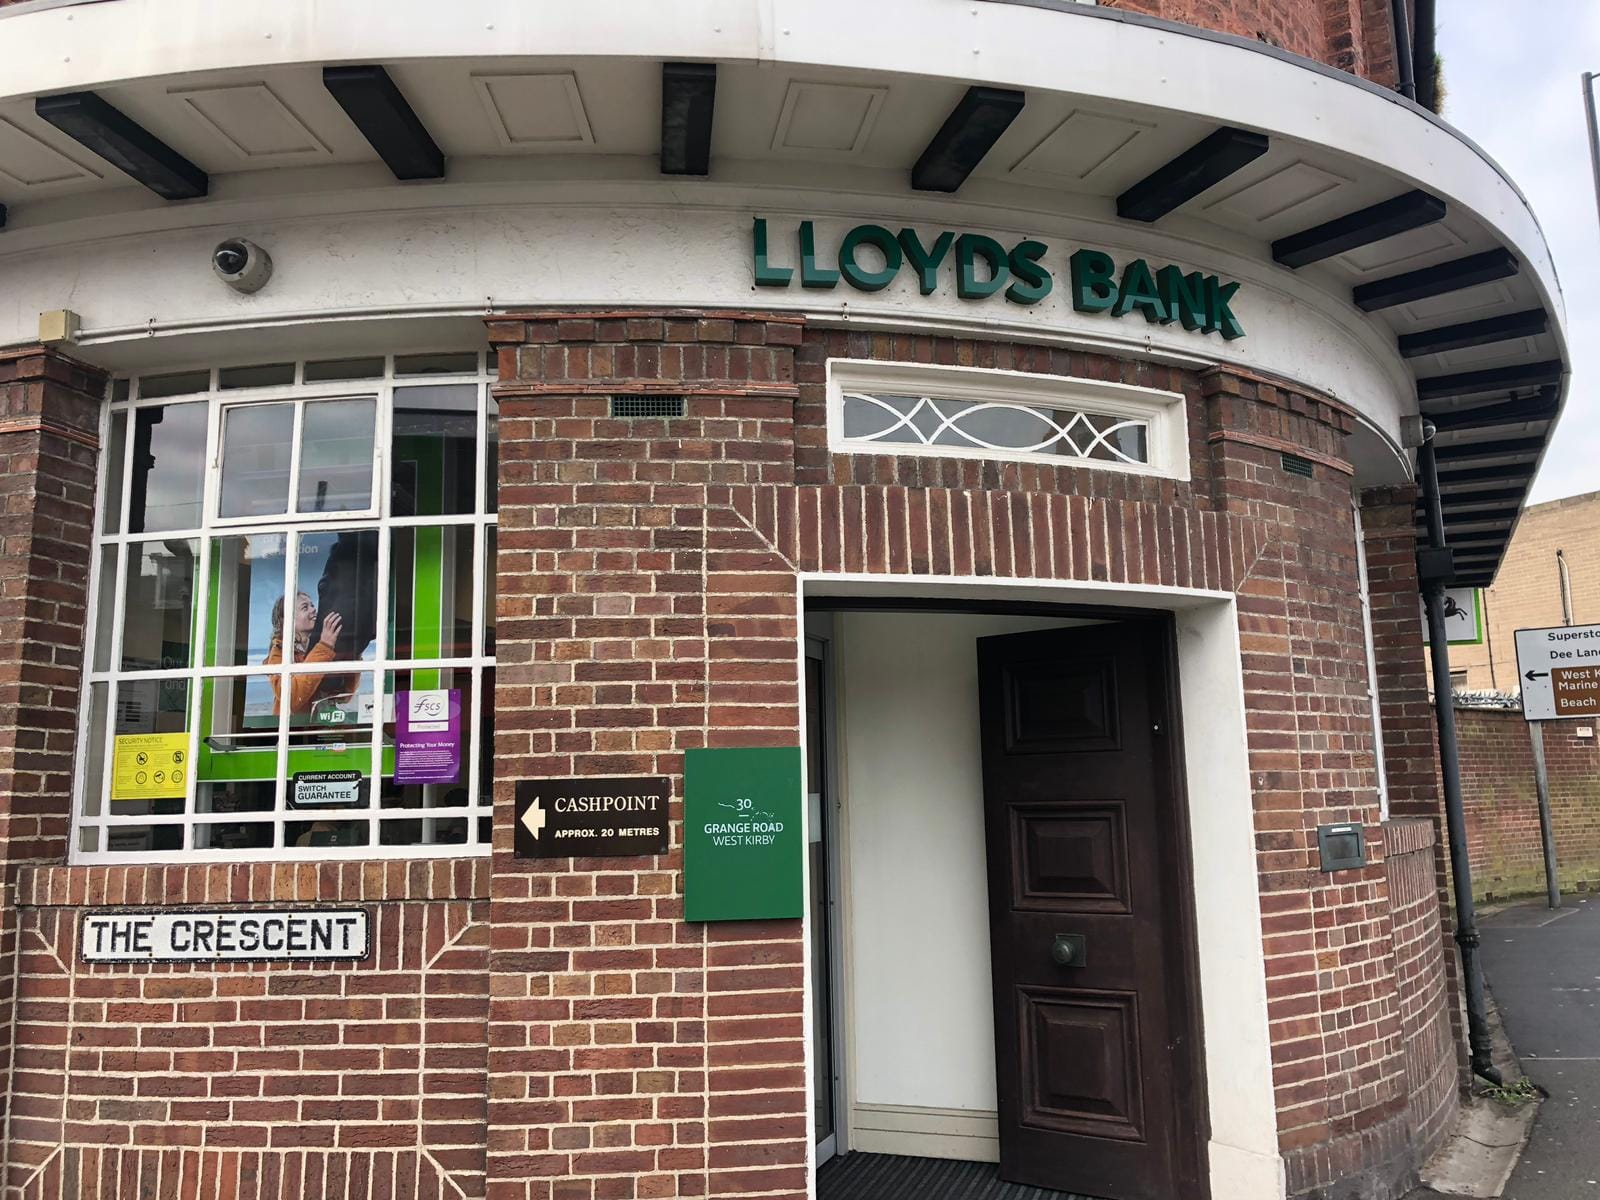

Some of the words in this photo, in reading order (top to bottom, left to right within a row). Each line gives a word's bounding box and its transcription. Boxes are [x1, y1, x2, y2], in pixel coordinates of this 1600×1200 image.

[753, 218, 1054, 304] LLOYDS
[1069, 248, 1246, 341] BANK
[1550, 649, 1572, 659] Dee
[1561, 669, 1590, 679] West
[1558, 680, 1598, 691] Marine
[1560, 697, 1596, 707] Beach
[297, 791, 352, 800] GUARANTEE
[555, 796, 659, 812] CASHPOINT
[736, 798, 751, 811] 30
[555, 829, 598, 838] APPROX.
[601, 828, 614, 837] 20
[618, 827, 659, 837] METRES
[704, 822, 750, 833] GRANGE
[752, 822, 783, 832] ROAD
[713, 835, 743, 845] WEST
[745, 834, 775, 845] KIRBY
[91, 920, 153, 952] THE
[170, 918, 357, 951] CRESCENT
